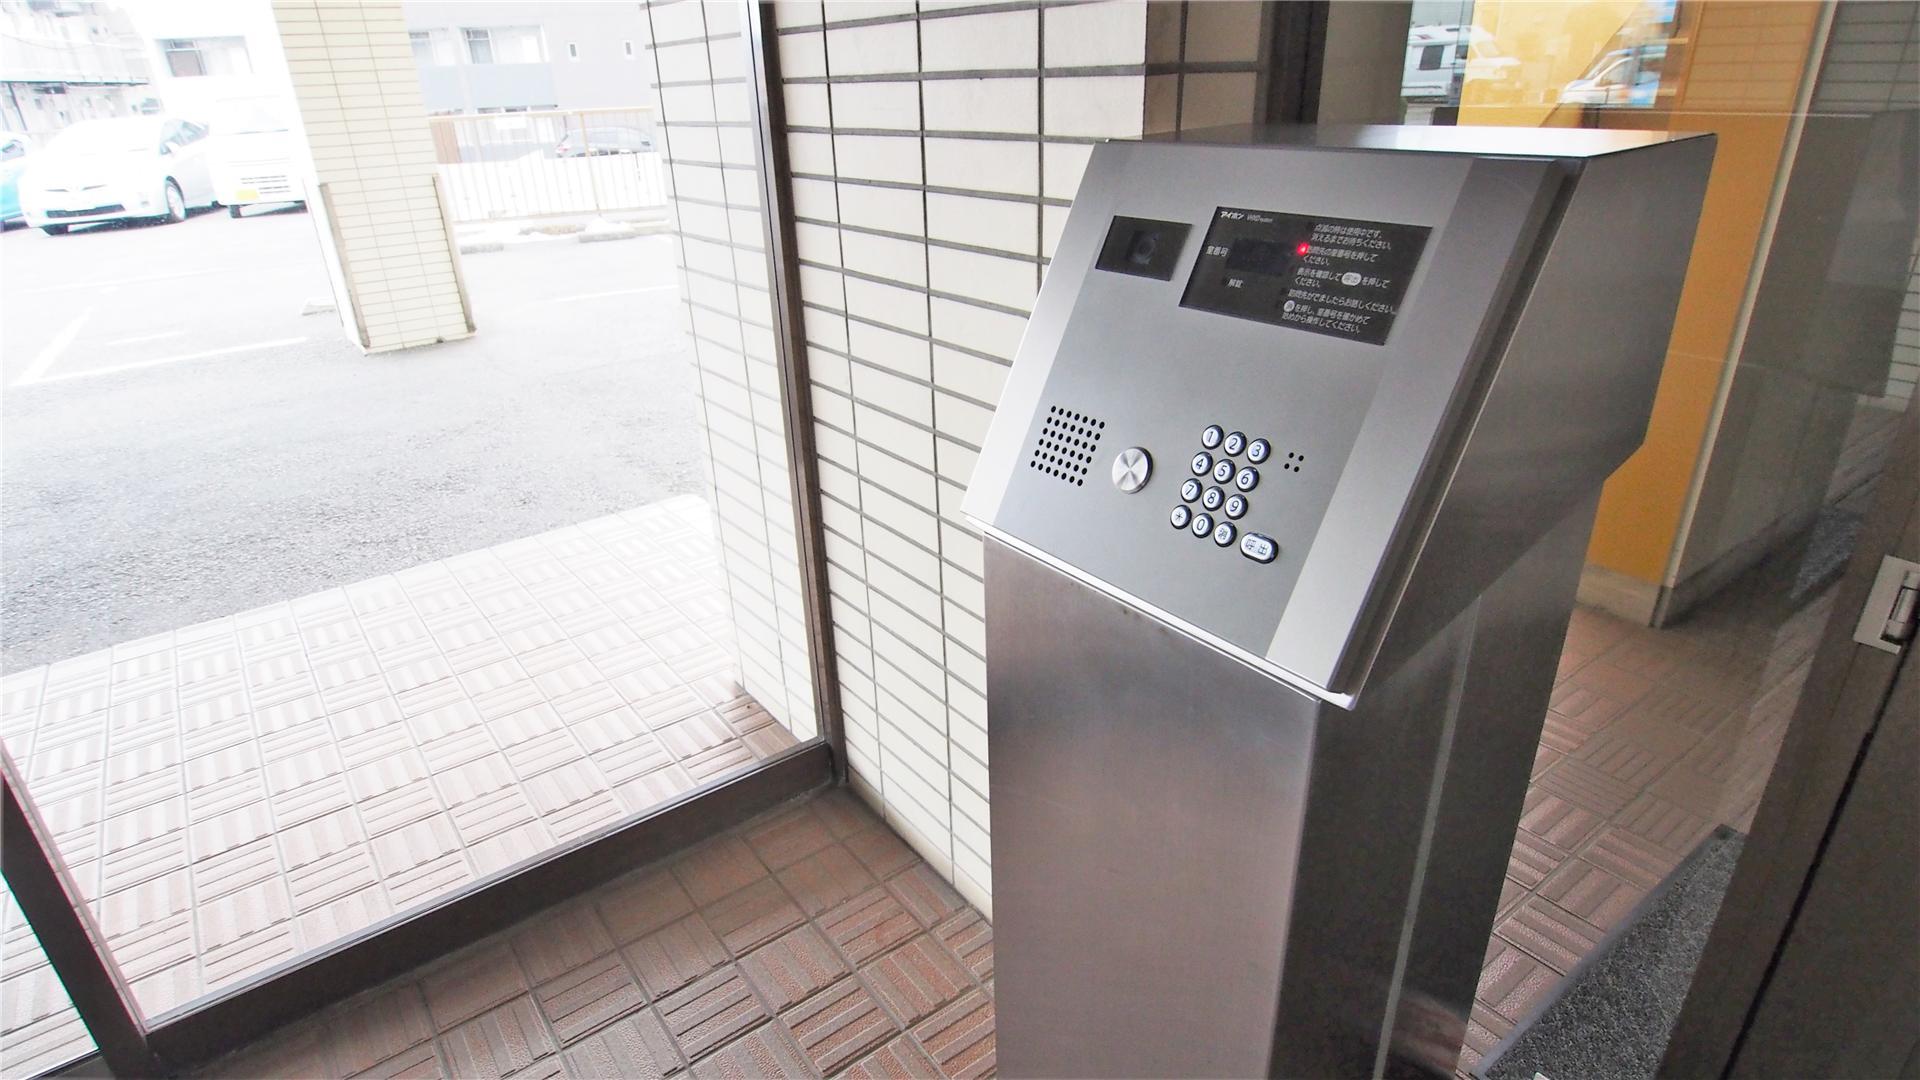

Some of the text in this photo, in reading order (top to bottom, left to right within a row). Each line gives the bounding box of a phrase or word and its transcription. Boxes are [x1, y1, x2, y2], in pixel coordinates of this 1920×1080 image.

[1220, 211, 1245, 220] アイホン
[1206, 245, 1229, 257] 室番号
[1229, 438, 1238, 450] 2
[1252, 445, 1261, 457] 3
[1196, 458, 1249, 485] 4 5 6
[1185, 484, 1239, 512] 7 8 9
[1197, 518, 1205, 530] 0
